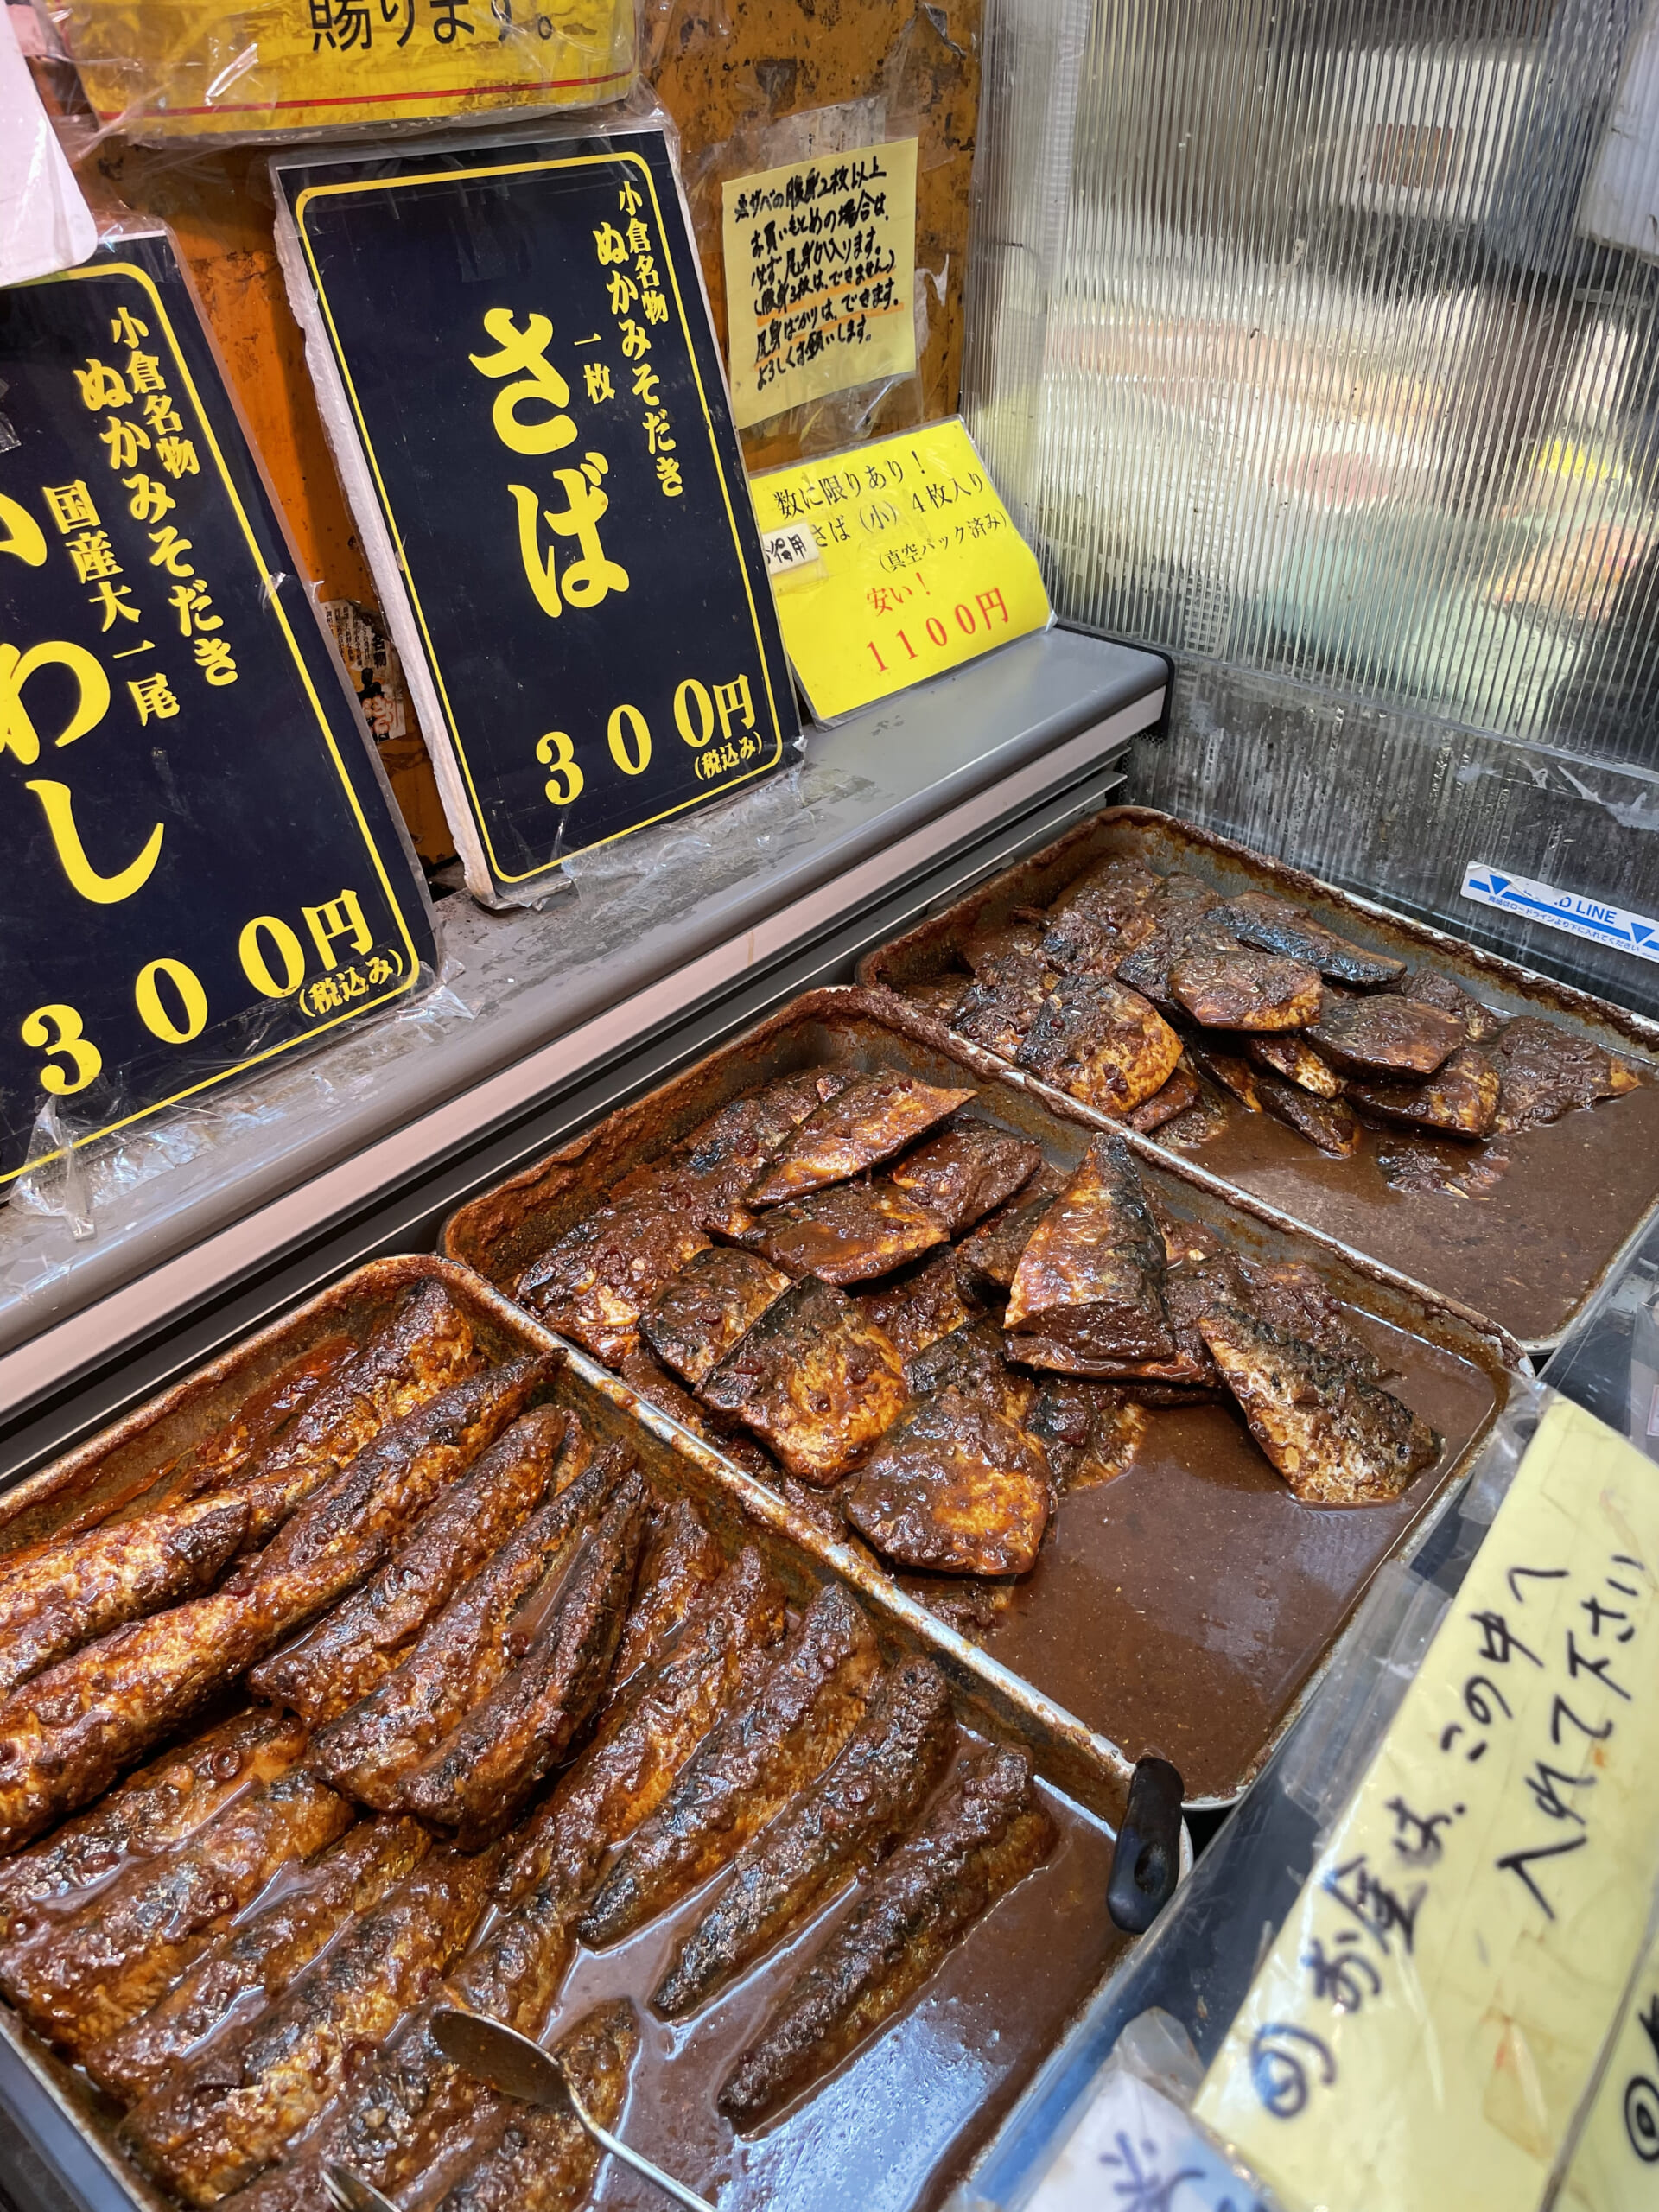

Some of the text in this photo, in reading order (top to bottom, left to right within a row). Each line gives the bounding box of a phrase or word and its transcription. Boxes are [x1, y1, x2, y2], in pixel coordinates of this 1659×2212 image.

[619, 181, 669, 325] 小倉名物
[111, 307, 200, 479] 小倉名物
[574, 332, 615, 404] 一枚
[593, 222, 684, 497] ぬかみそだき
[73, 359, 239, 686] ぬかみそだき
[468, 308, 630, 619] さば
[866, 587, 1009, 673] 1100円
[1488, 895, 1640, 952] 商品はロードラインより下に入れてください
[1576, 900, 1618, 925] LINE
